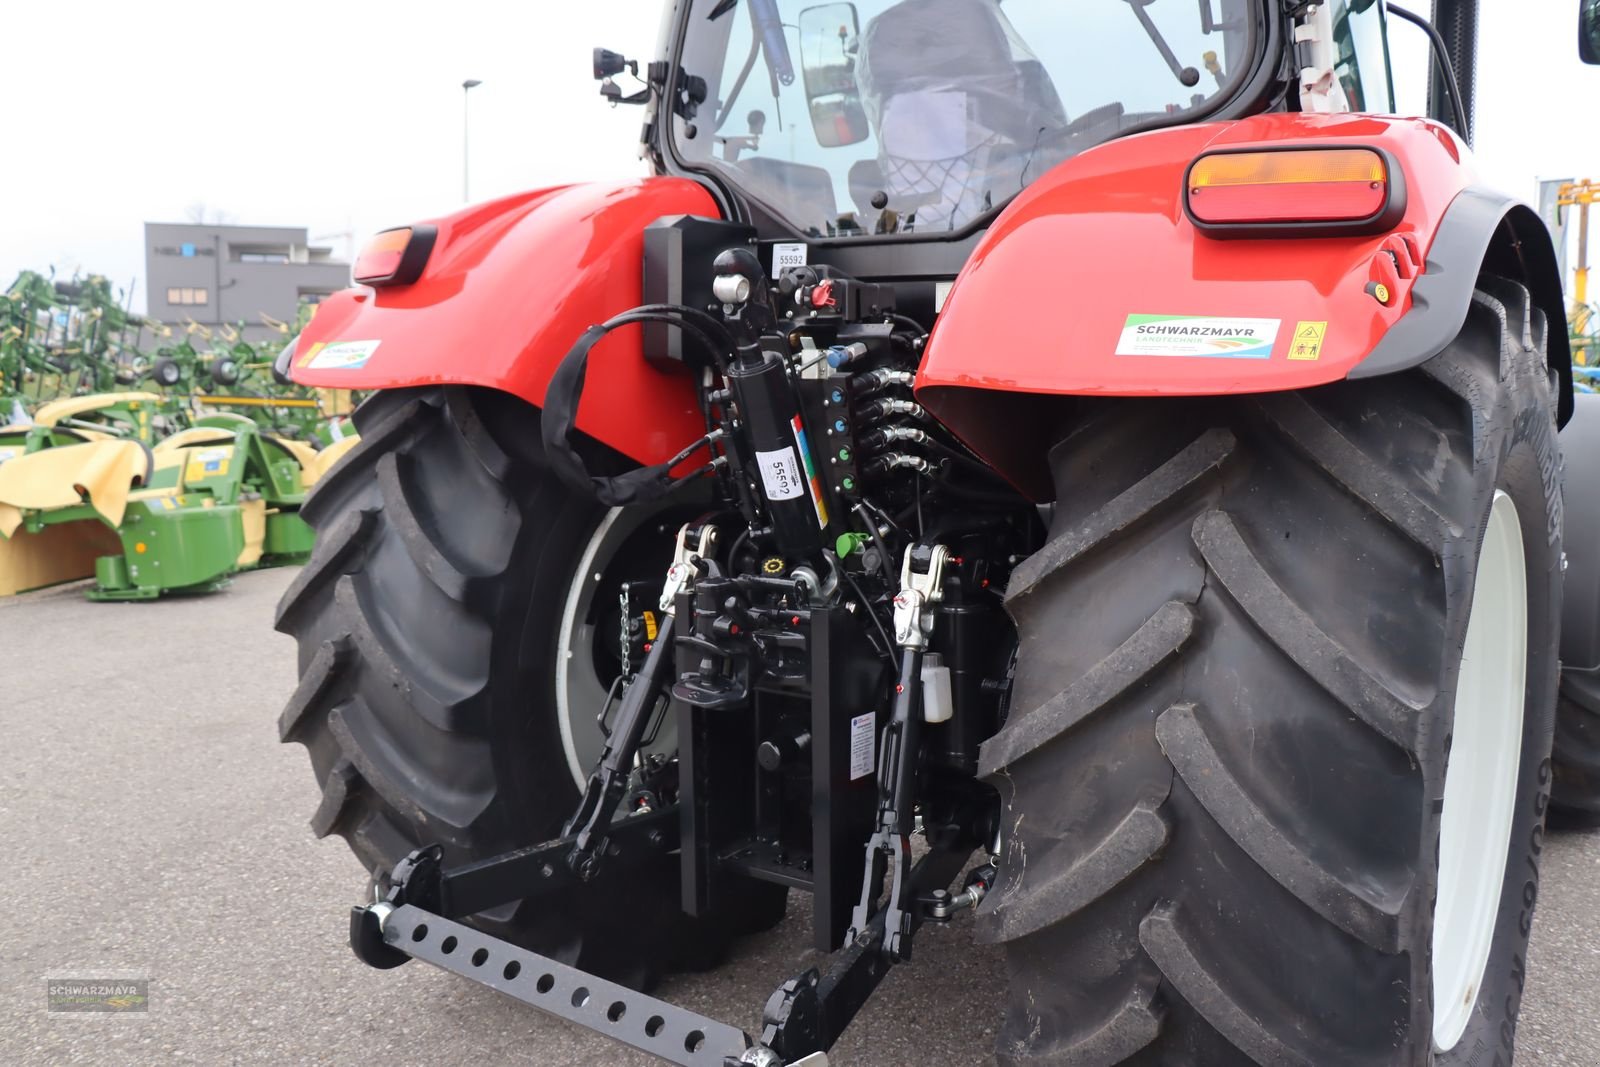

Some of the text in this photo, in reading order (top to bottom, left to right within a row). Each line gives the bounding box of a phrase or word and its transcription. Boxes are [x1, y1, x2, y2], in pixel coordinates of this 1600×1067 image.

[779, 255, 803, 265] 55592
[1136, 325, 1255, 337] SCHWARZMAYR
[1135, 336, 1204, 344] LANDTECHNIK
[773, 461, 790, 495] 55592
